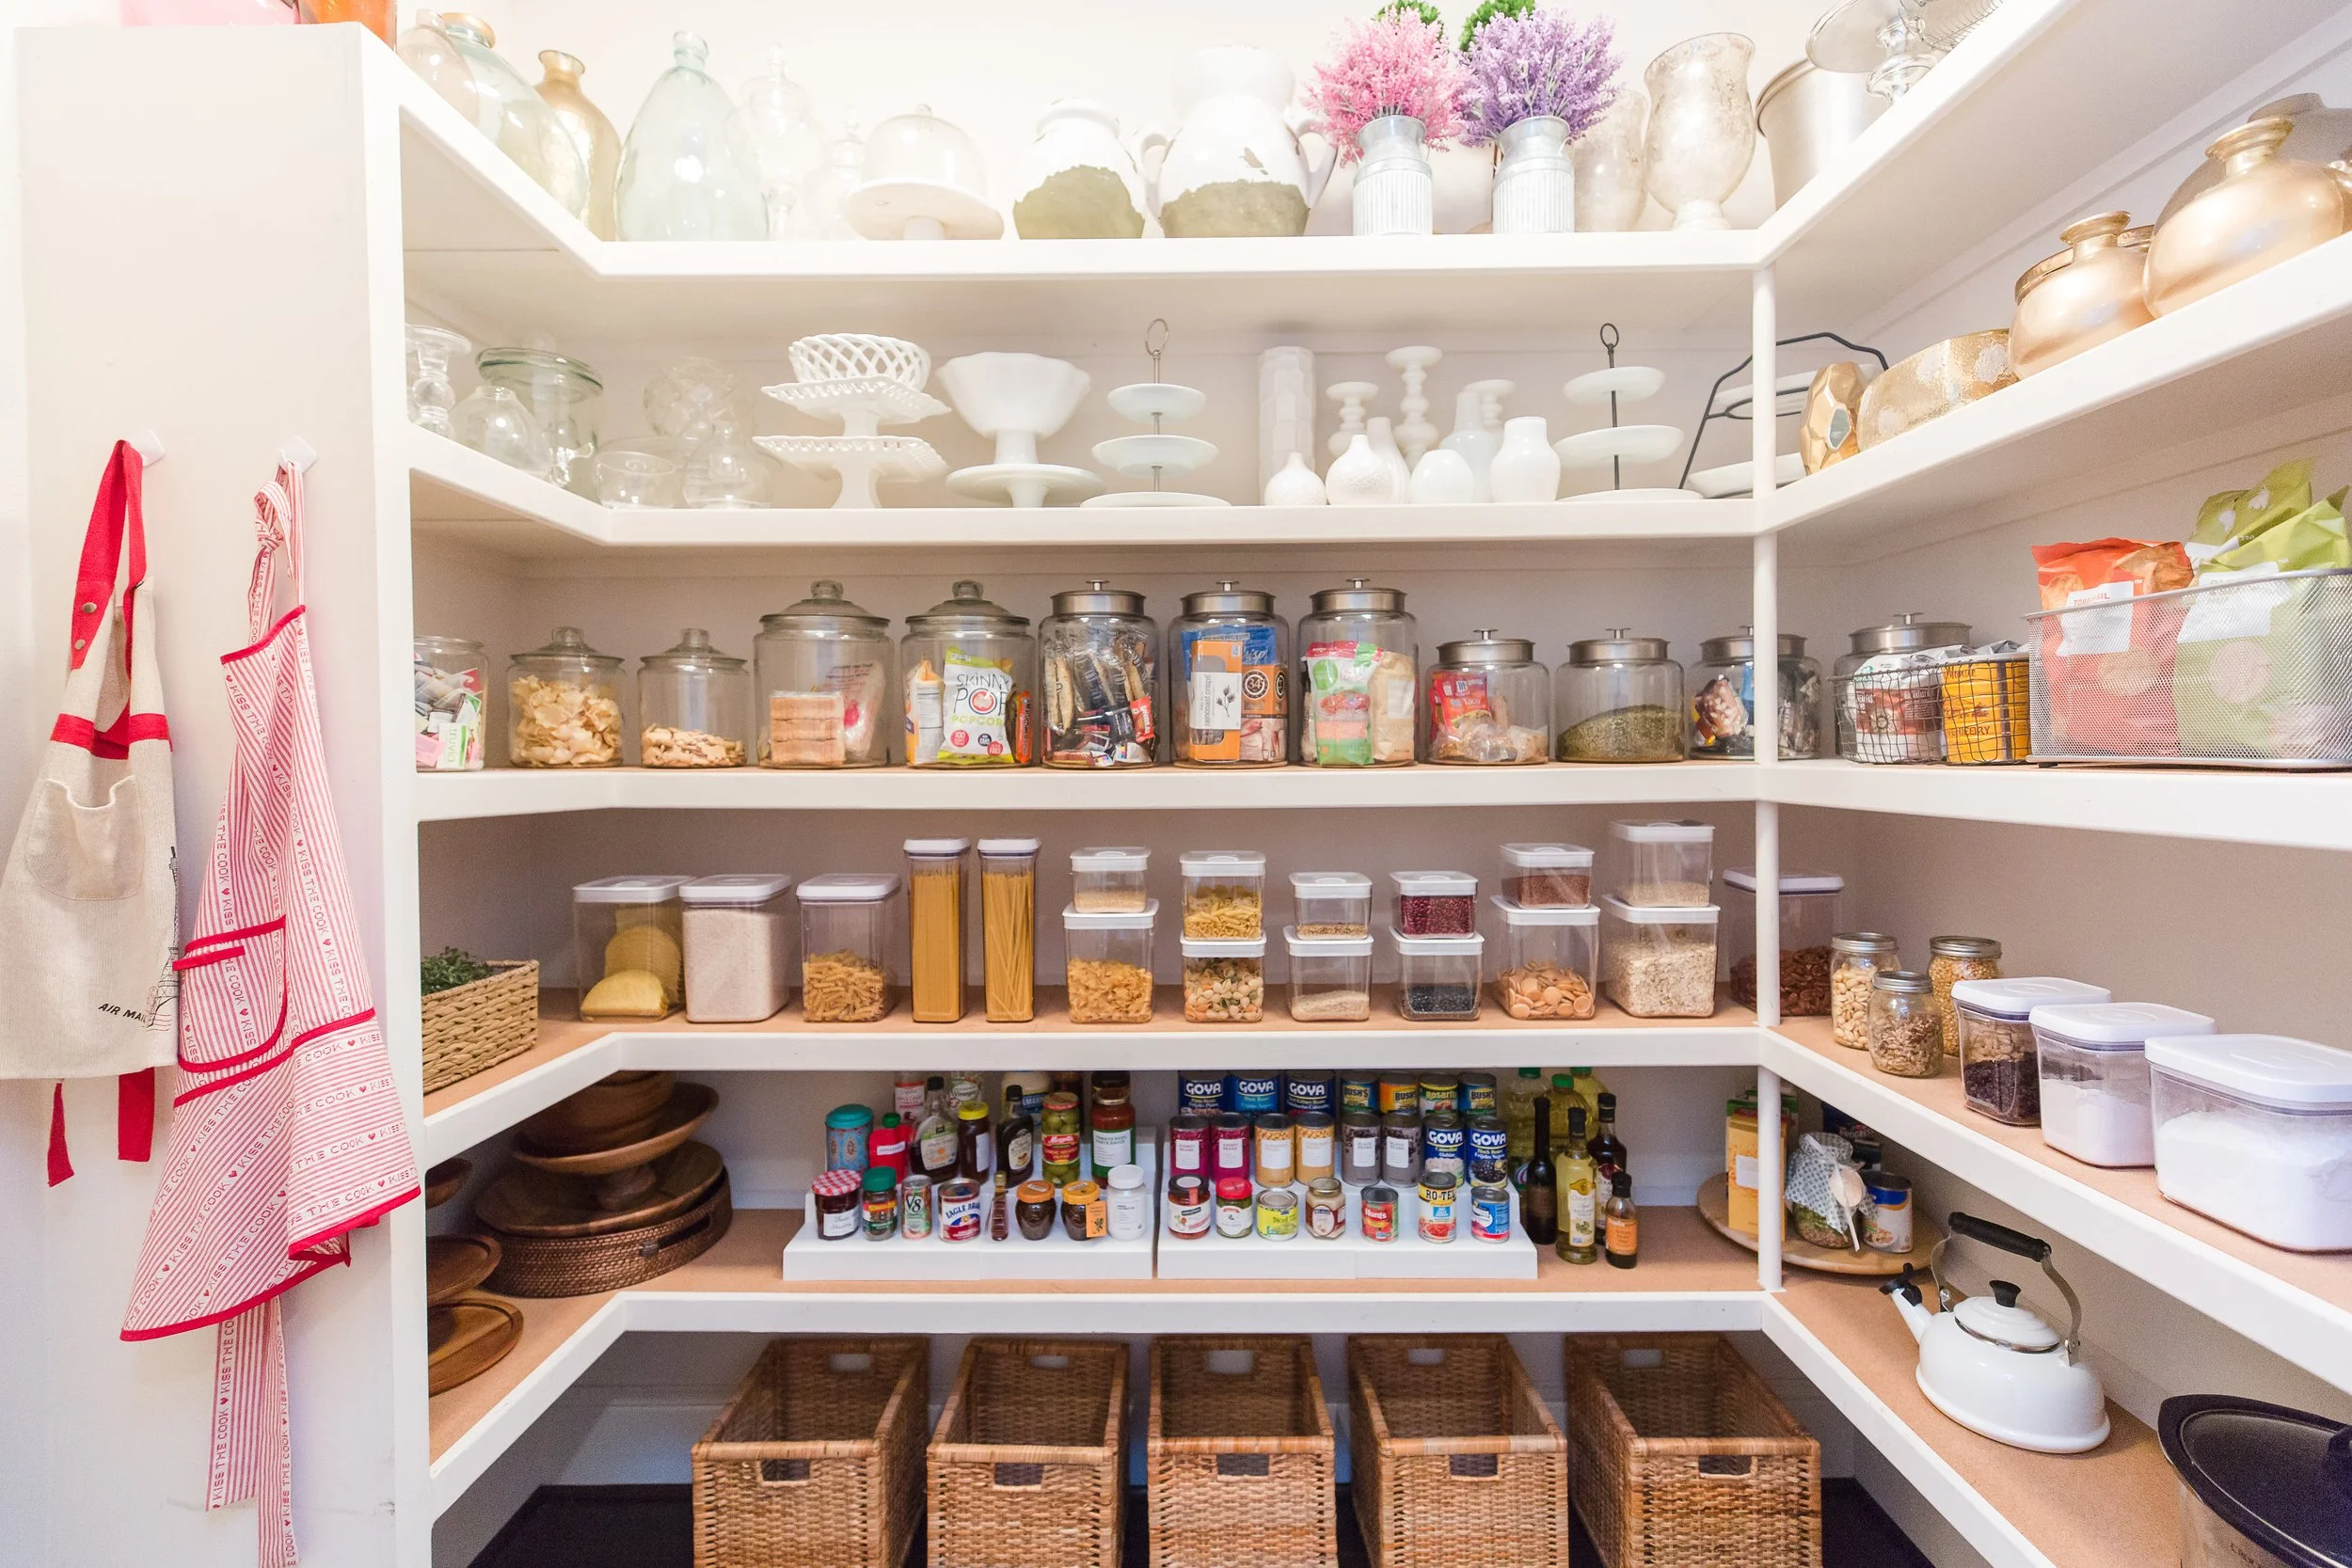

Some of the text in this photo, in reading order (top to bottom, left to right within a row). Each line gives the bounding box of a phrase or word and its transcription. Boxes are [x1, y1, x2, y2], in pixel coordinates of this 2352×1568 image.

[230, 686, 250, 711] KISS
[246, 713, 264, 736] THE
[217, 824, 227, 849] THE
[216, 852, 230, 884] COOK
[222, 898, 234, 927] KISS
[298, 849, 311, 877] KISS
[306, 879, 319, 903] THE
[313, 905, 329, 935] COOK
[326, 948, 341, 976] KISS
[334, 978, 348, 1003] THE
[98, 1003, 120, 1016] AIR
[230, 974, 246, 1006] COOK
[241, 1020, 257, 1047] KISS
[305, 1042, 343, 1063] COOK
[315, 1088, 356, 1108] COOK
[1185, 1083, 1221, 1095] GOYA
[1239, 1081, 1274, 1093] GOYA
[1289, 1083, 1325, 1096] GOYA
[171, 1155, 192, 1183] COOK
[196, 1118, 216, 1145] KISS
[215, 1094, 237, 1117] THE
[294, 1149, 326, 1169] THE
[330, 1135, 364, 1154] COOK
[1429, 1132, 1463, 1144] GOYA
[1471, 1132, 1506, 1146] GOYA
[203, 1181, 230, 1212] COOK
[237, 1140, 264, 1169] KISS
[262, 1117, 281, 1140] THE
[307, 1197, 340, 1216] THE
[344, 1183, 376, 1203] COOK
[905, 1195, 922, 1213] V8
[946, 1204, 966, 1219] EAGLE
[225, 1236, 250, 1261] THE
[248, 1201, 280, 1234] COOK
[140, 1275, 163, 1306] COOK
[169, 1235, 193, 1263] KISS
[222, 1338, 234, 1364] THE
[220, 1366, 232, 1394] KISS
[217, 1408, 230, 1440] COOK
[215, 1443, 228, 1469] THE
[281, 1430, 291, 1459] COOK
[213, 1472, 225, 1501] KISS
[282, 1463, 292, 1486] THE
[282, 1489, 291, 1517] KISS
[284, 1528, 295, 1558] COOK
